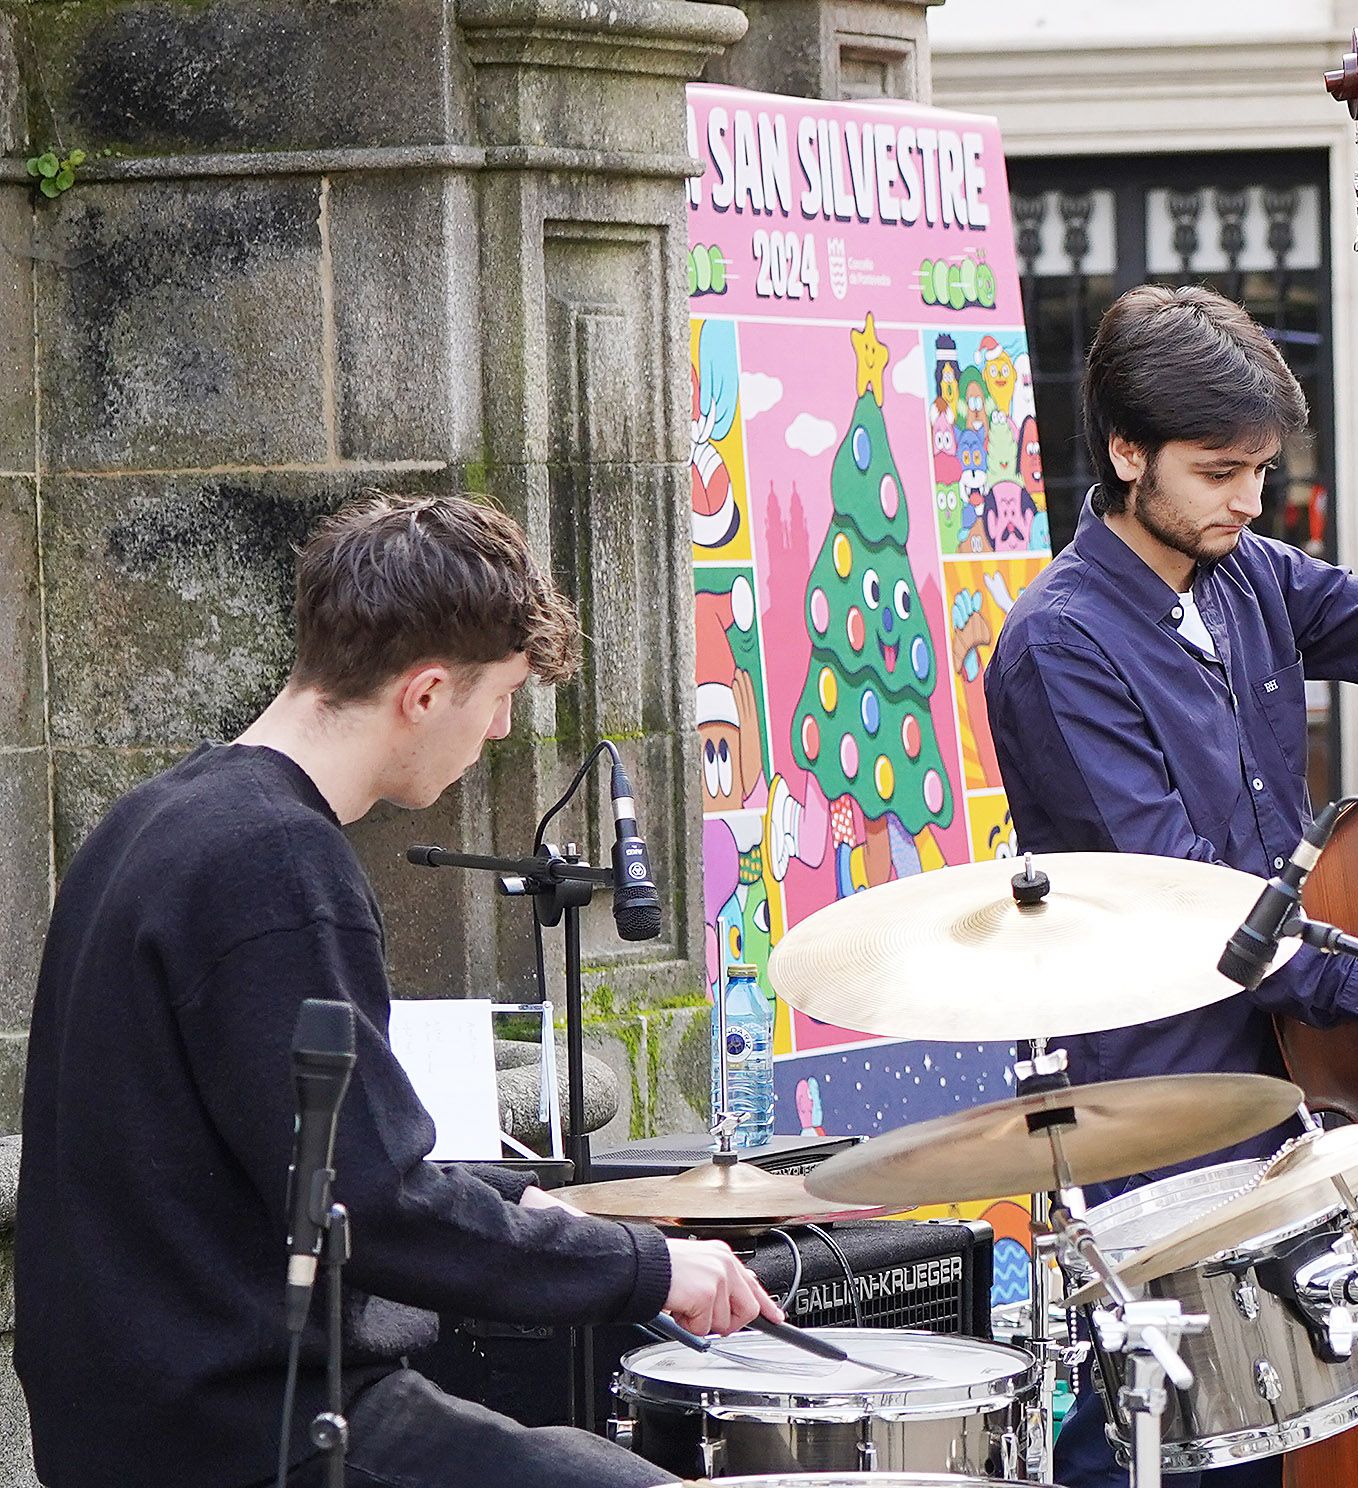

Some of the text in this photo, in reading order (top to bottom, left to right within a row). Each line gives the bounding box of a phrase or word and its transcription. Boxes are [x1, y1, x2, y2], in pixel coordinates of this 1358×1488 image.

[707, 107, 791, 217] SAN
[797, 116, 991, 231] SILVESTRE
[752, 228, 819, 300] 2024
